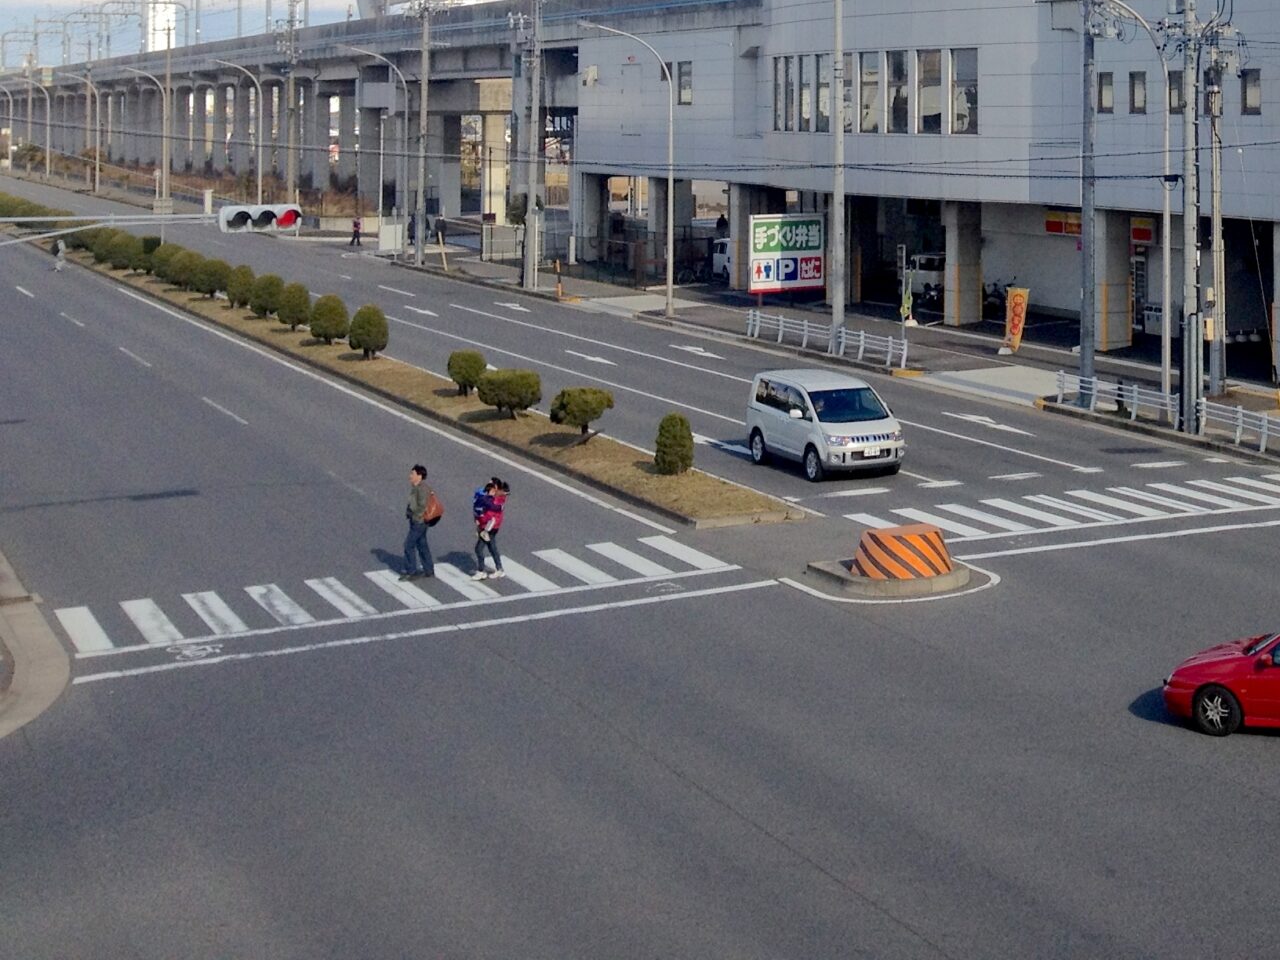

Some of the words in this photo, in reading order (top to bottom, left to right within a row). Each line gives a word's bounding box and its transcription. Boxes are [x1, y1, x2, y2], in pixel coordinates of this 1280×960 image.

[755, 224, 820, 249] 手づくり弁当
[779, 260, 794, 279] P
[801, 259, 821, 278] たばこ
